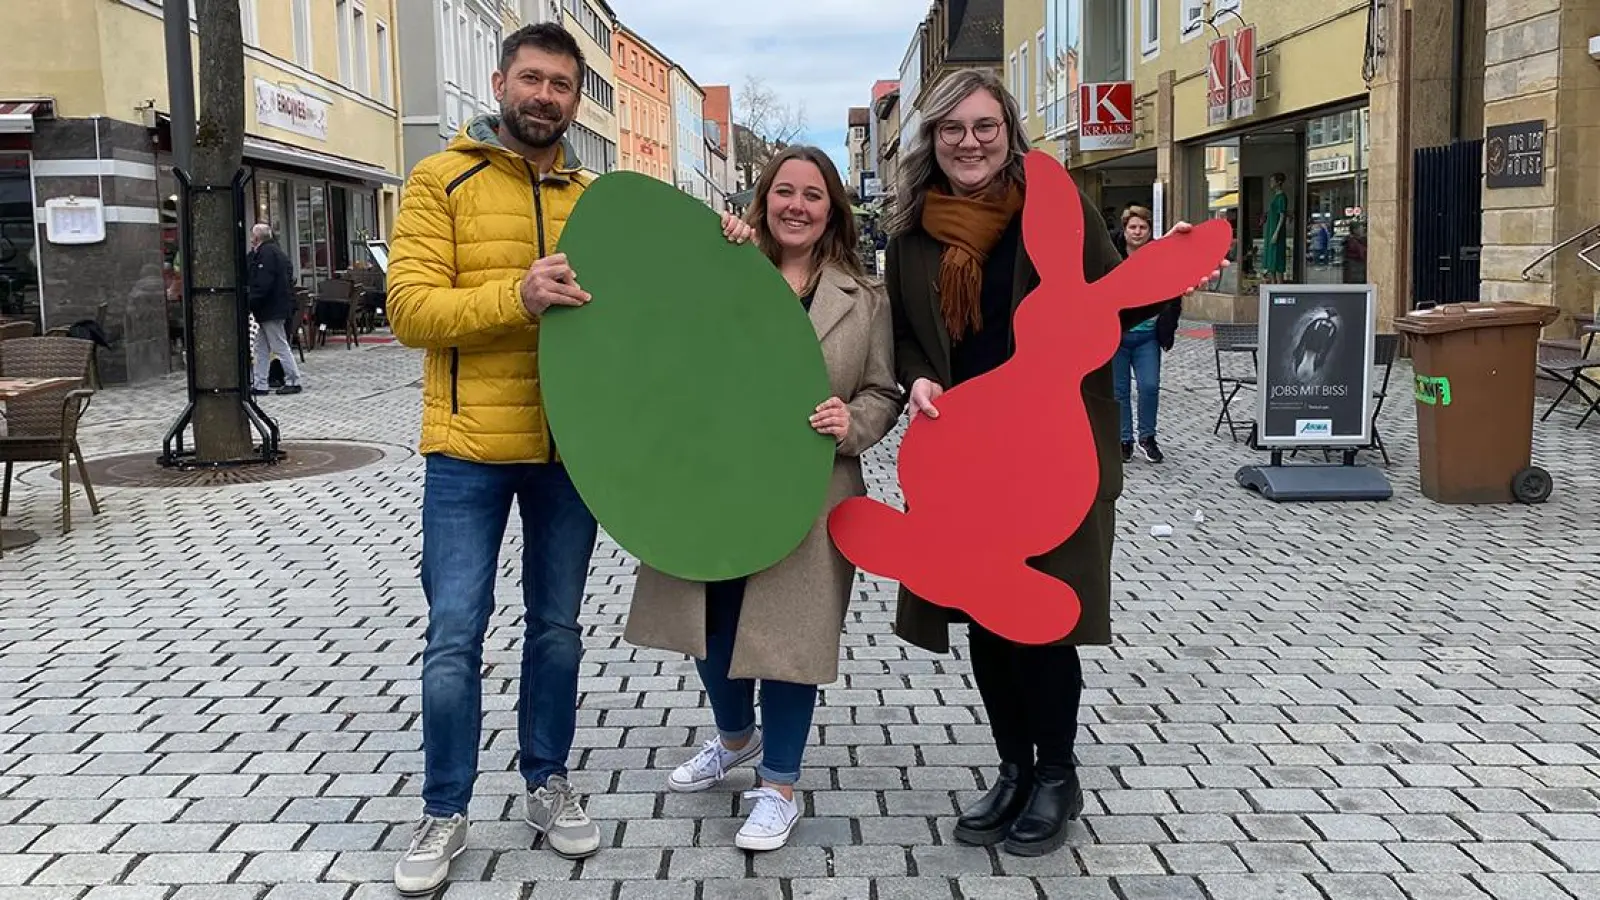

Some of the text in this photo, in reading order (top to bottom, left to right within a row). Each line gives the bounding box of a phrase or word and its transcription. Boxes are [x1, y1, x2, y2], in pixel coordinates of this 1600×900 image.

[1083, 83, 1131, 124] K
[1083, 123, 1131, 136] KRAUSE
[1270, 385, 1348, 399] JOBS MIT BISS!
